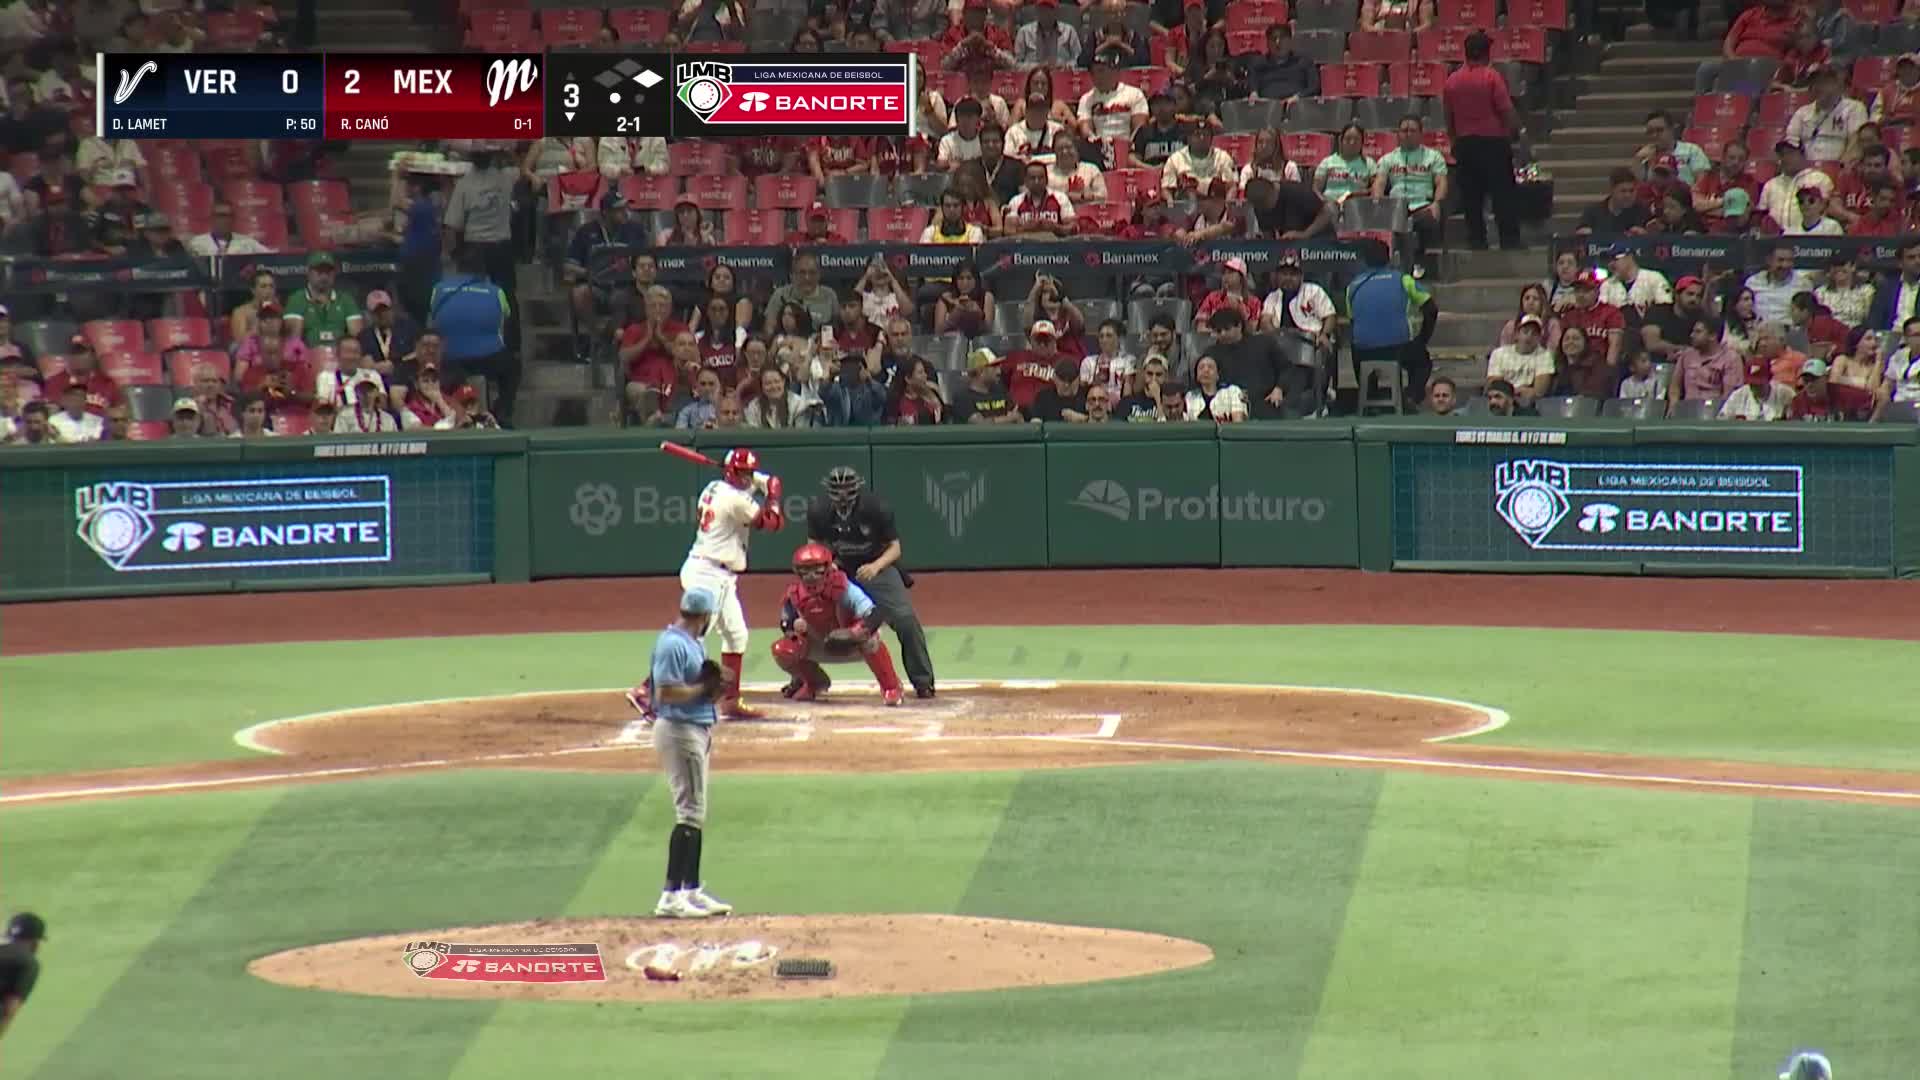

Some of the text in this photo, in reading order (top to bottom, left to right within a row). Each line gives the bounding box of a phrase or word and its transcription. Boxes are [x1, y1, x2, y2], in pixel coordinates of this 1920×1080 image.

[1014, 253, 1070, 264] Banamex
[1102, 252, 1159, 263] Banamex
[1301, 248, 1357, 260] Banamex
[1671, 245, 1725, 257] Banamex
[1496, 460, 1570, 491] LMB
[76, 483, 154, 515] LMB
[1138, 484, 1326, 521] Profuturo
[1626, 510, 1793, 533] BANORTE
[212, 521, 380, 548] BANORTE
